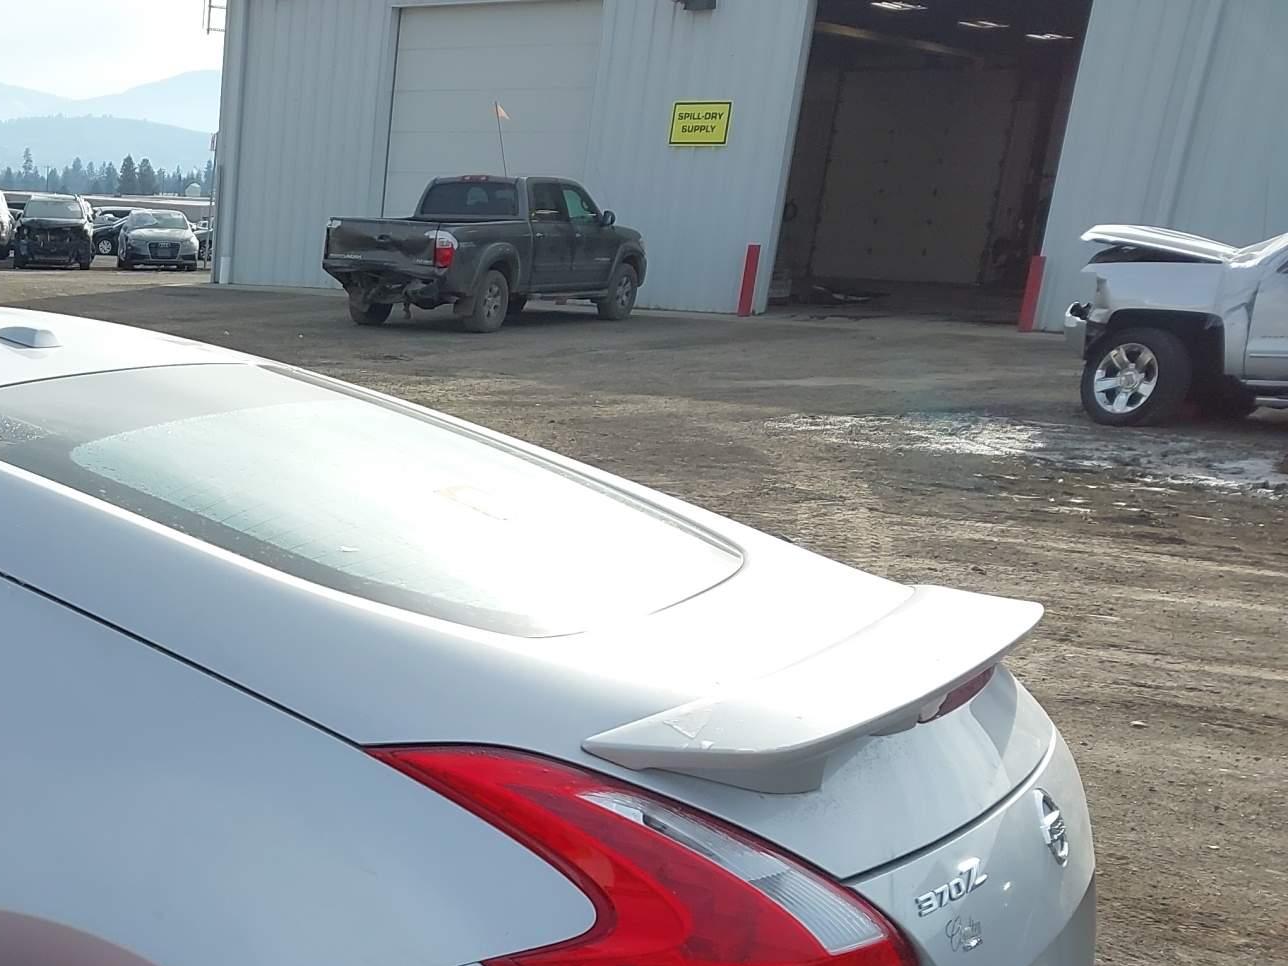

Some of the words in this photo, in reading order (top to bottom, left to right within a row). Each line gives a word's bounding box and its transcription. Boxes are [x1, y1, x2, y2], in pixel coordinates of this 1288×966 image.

[677, 112, 724, 121] SPILL-DRY
[681, 124, 717, 133] SUPPLY
[915, 857, 988, 917] 370Z
